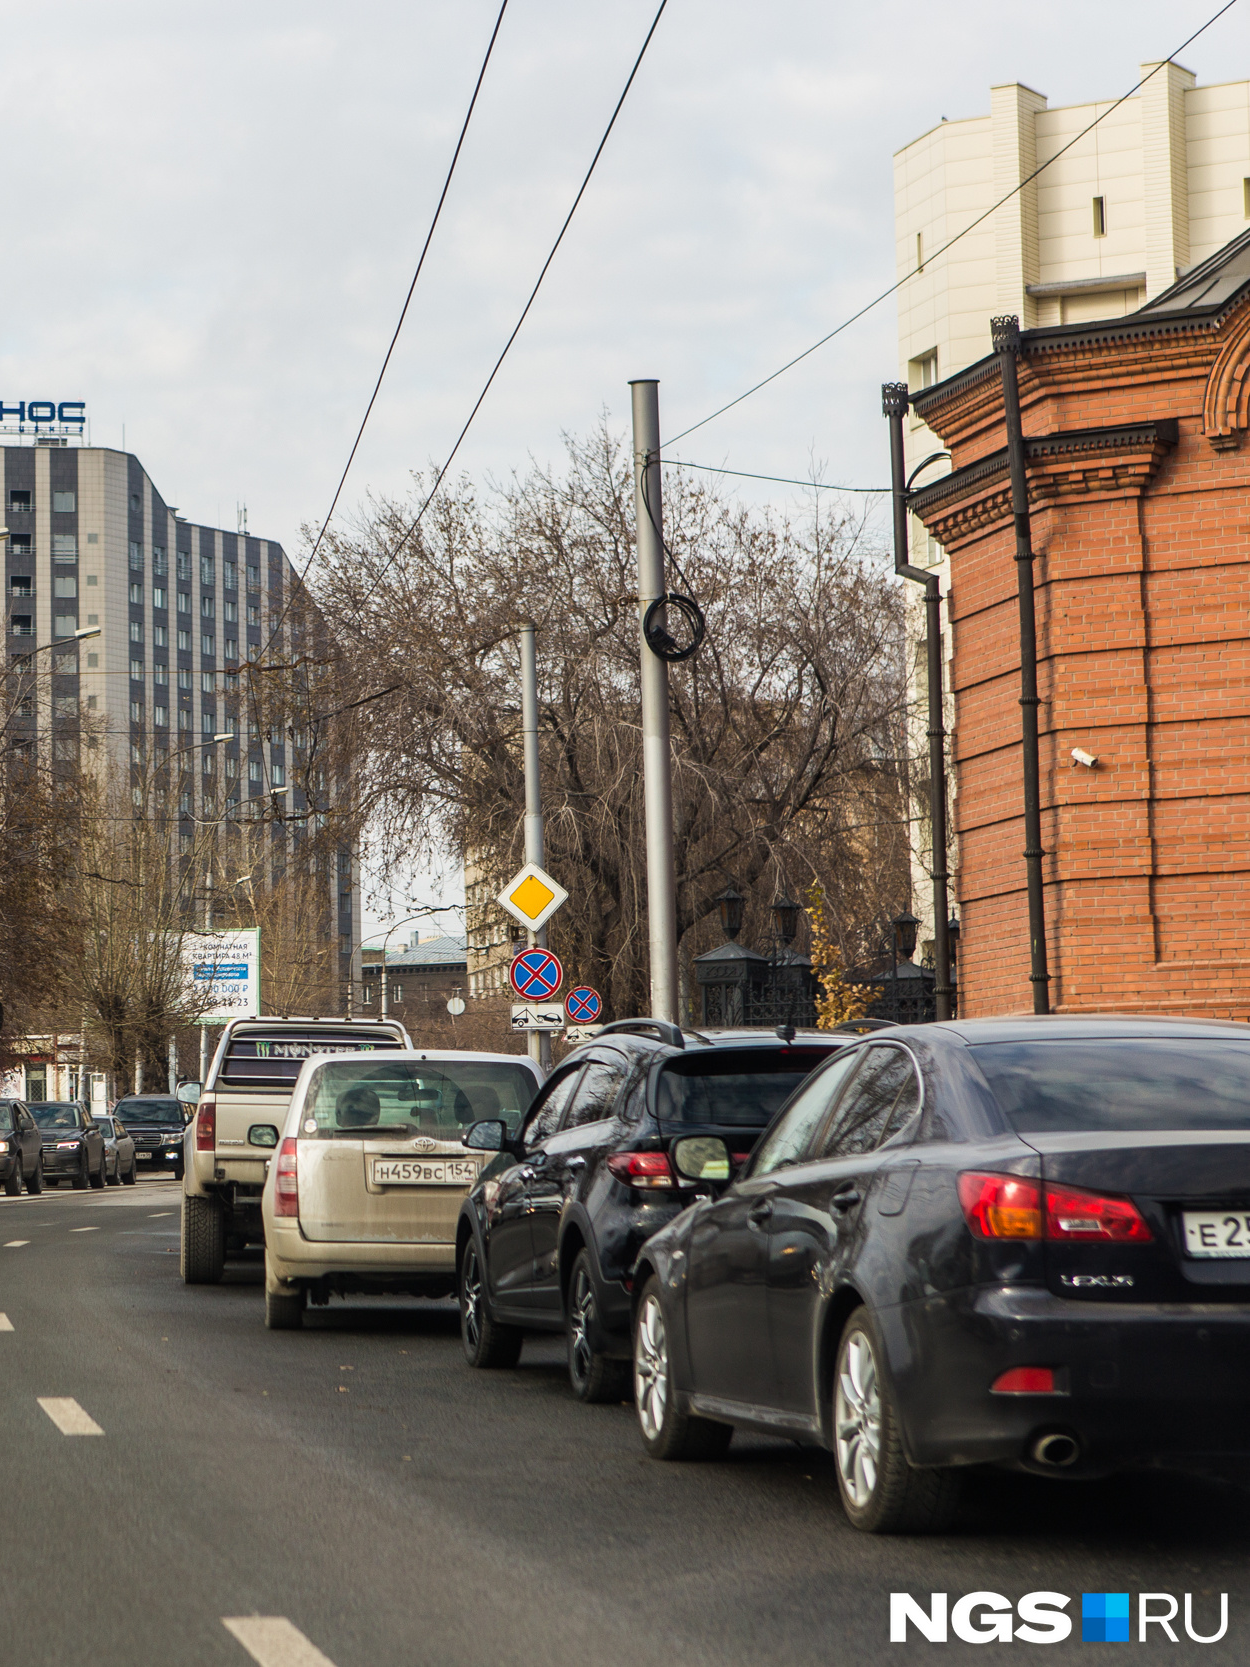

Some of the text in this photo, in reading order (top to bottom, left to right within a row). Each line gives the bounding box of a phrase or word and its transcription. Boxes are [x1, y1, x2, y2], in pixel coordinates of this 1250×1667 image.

[192, 952, 230, 960] КВАРТИРА
[222, 984, 240, 993] 000
[447, 1163, 474, 1176] 154
[1060, 1274, 1135, 1287] LEXUS
